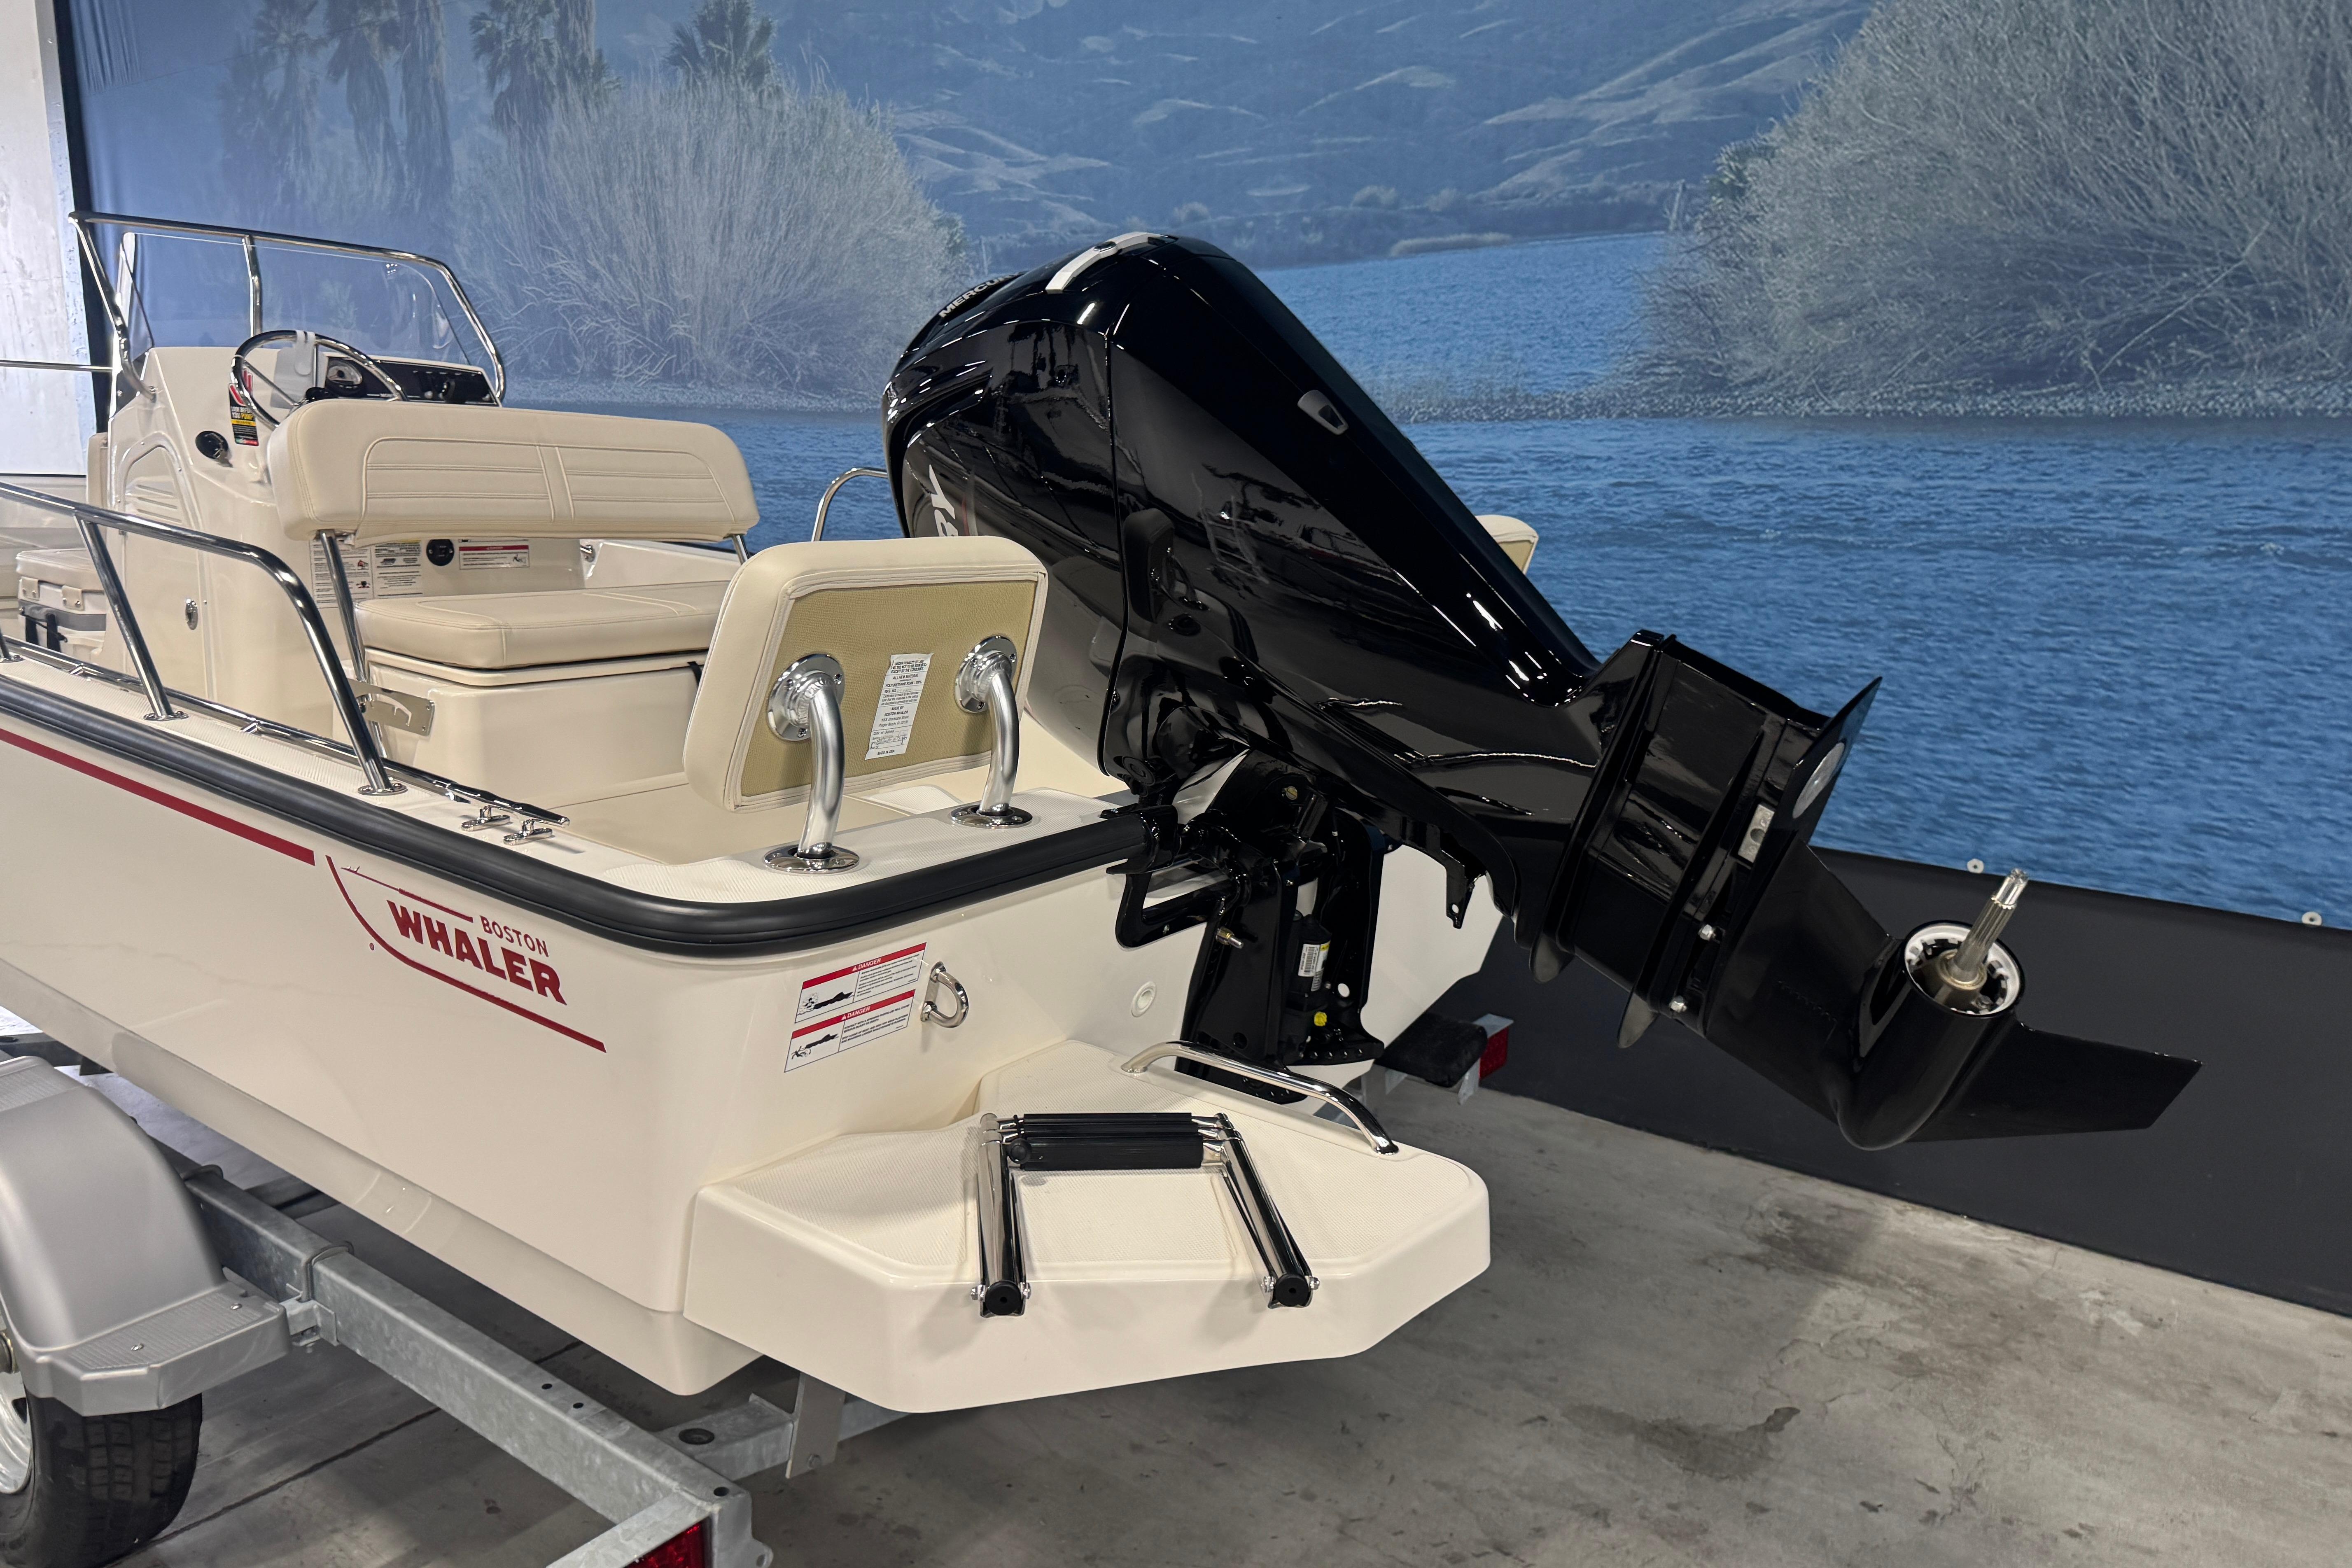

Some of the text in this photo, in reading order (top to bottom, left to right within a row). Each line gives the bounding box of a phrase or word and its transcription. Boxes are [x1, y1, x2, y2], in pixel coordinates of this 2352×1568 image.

[938, 273, 1019, 317] MERCUR
[386, 899, 567, 1006] WHALER
[480, 915, 549, 957] BOSTON
[858, 958, 882, 970] DANGER
[847, 1006, 870, 1018] DANGER
